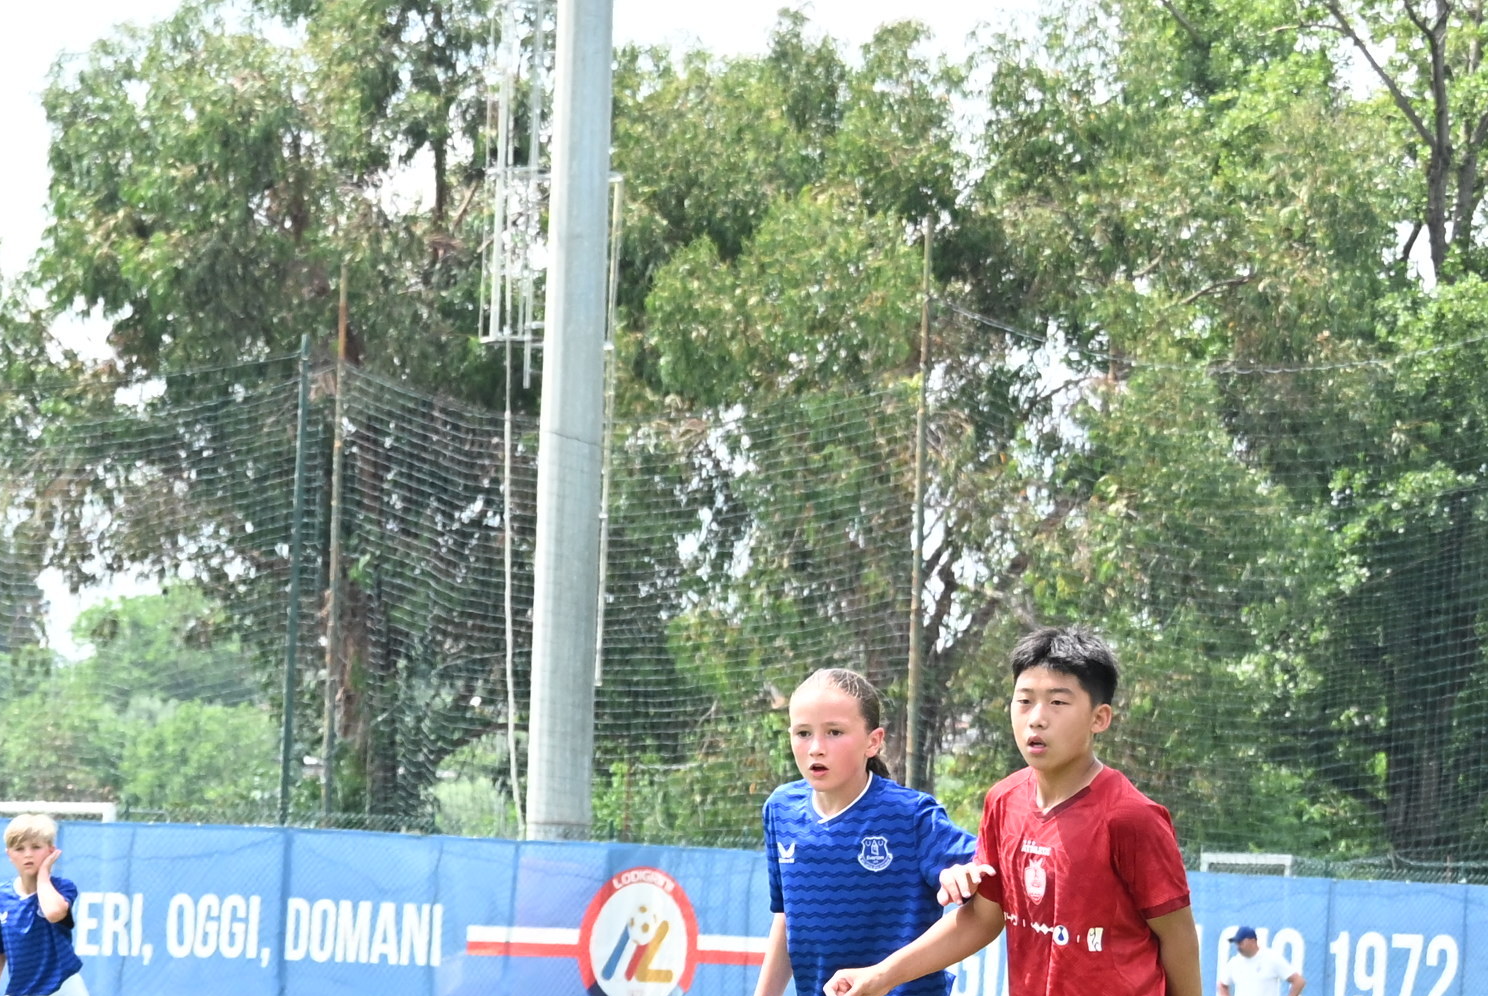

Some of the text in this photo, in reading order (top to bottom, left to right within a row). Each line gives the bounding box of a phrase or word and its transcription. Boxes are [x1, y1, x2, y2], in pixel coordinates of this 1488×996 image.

[75, 891, 443, 967] ERI, OGGI, DOMANI
